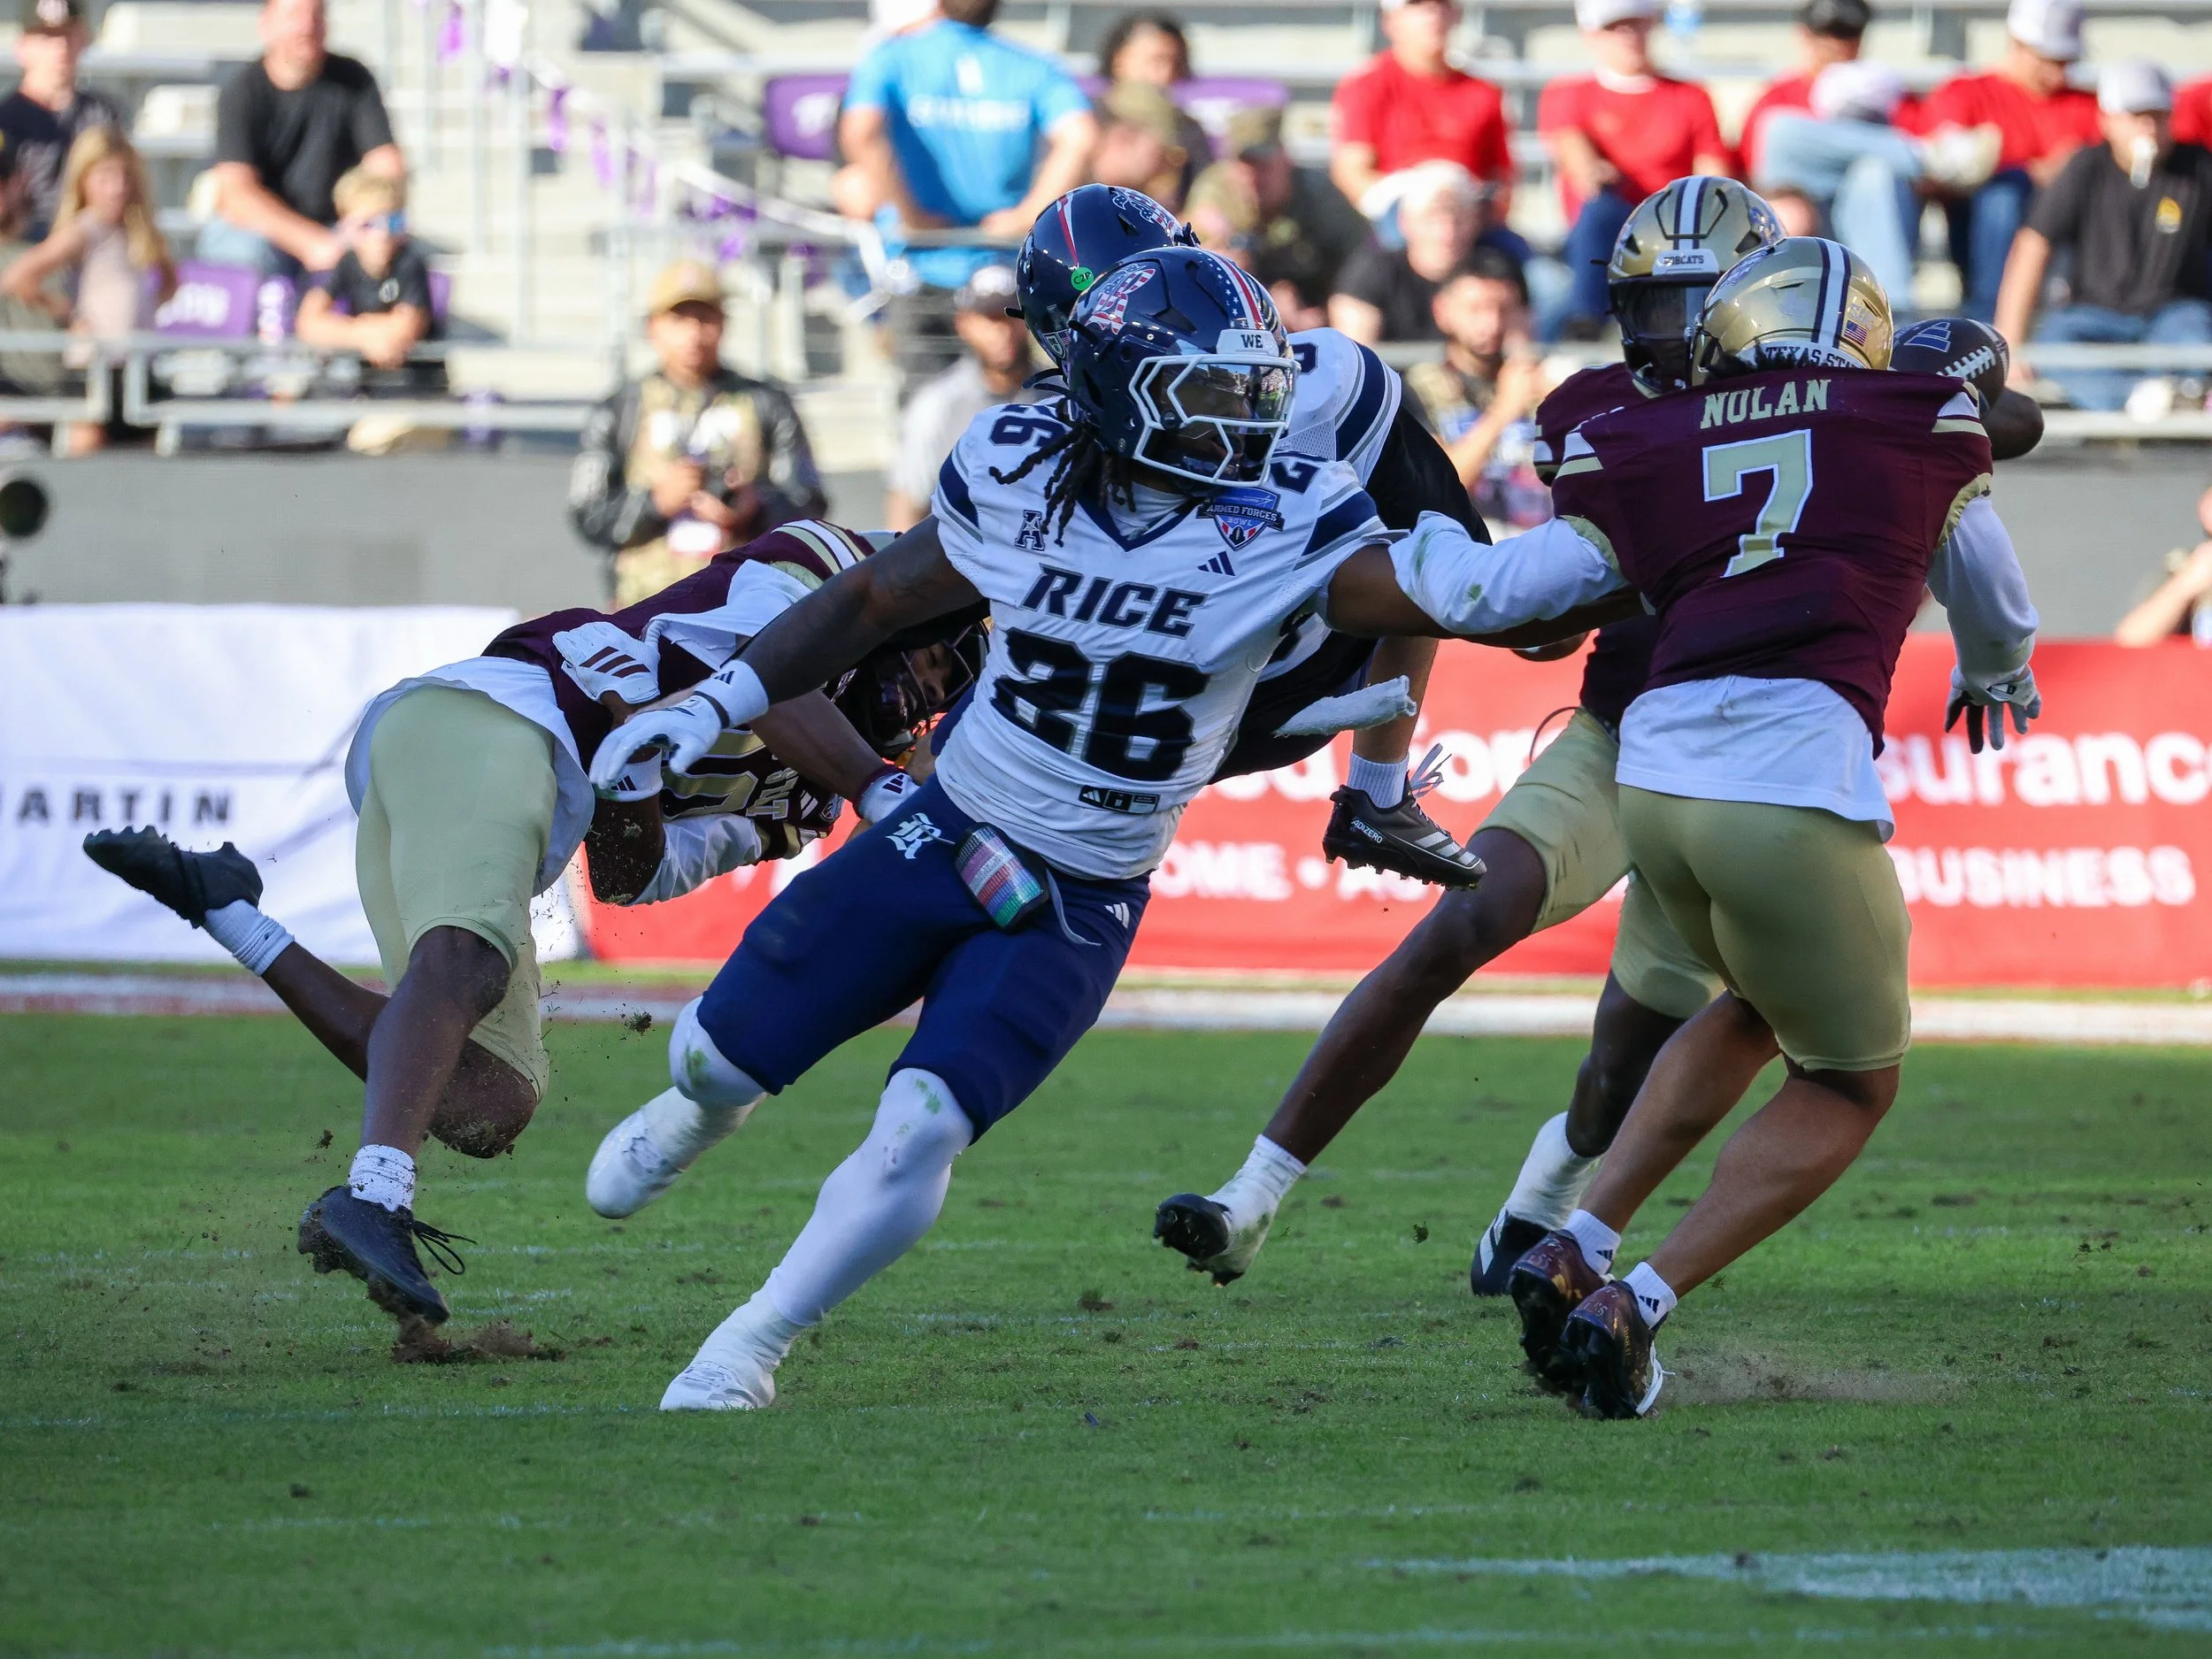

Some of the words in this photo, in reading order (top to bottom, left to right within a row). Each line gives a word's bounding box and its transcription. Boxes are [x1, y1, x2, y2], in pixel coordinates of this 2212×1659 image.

[1240, 334, 1263, 349] WE
[1699, 379, 1832, 430] NOLAN
[1207, 504, 1240, 514] ARMED
[1240, 506, 1278, 522] FORCES
[1226, 516, 1253, 527] BOWL
[1702, 428, 1813, 579] 7
[1019, 563, 1209, 640] RICE
[990, 626, 1211, 782] 26
[0, 786, 233, 823] ARTIN
[1349, 818, 1384, 845] ADIZERO
